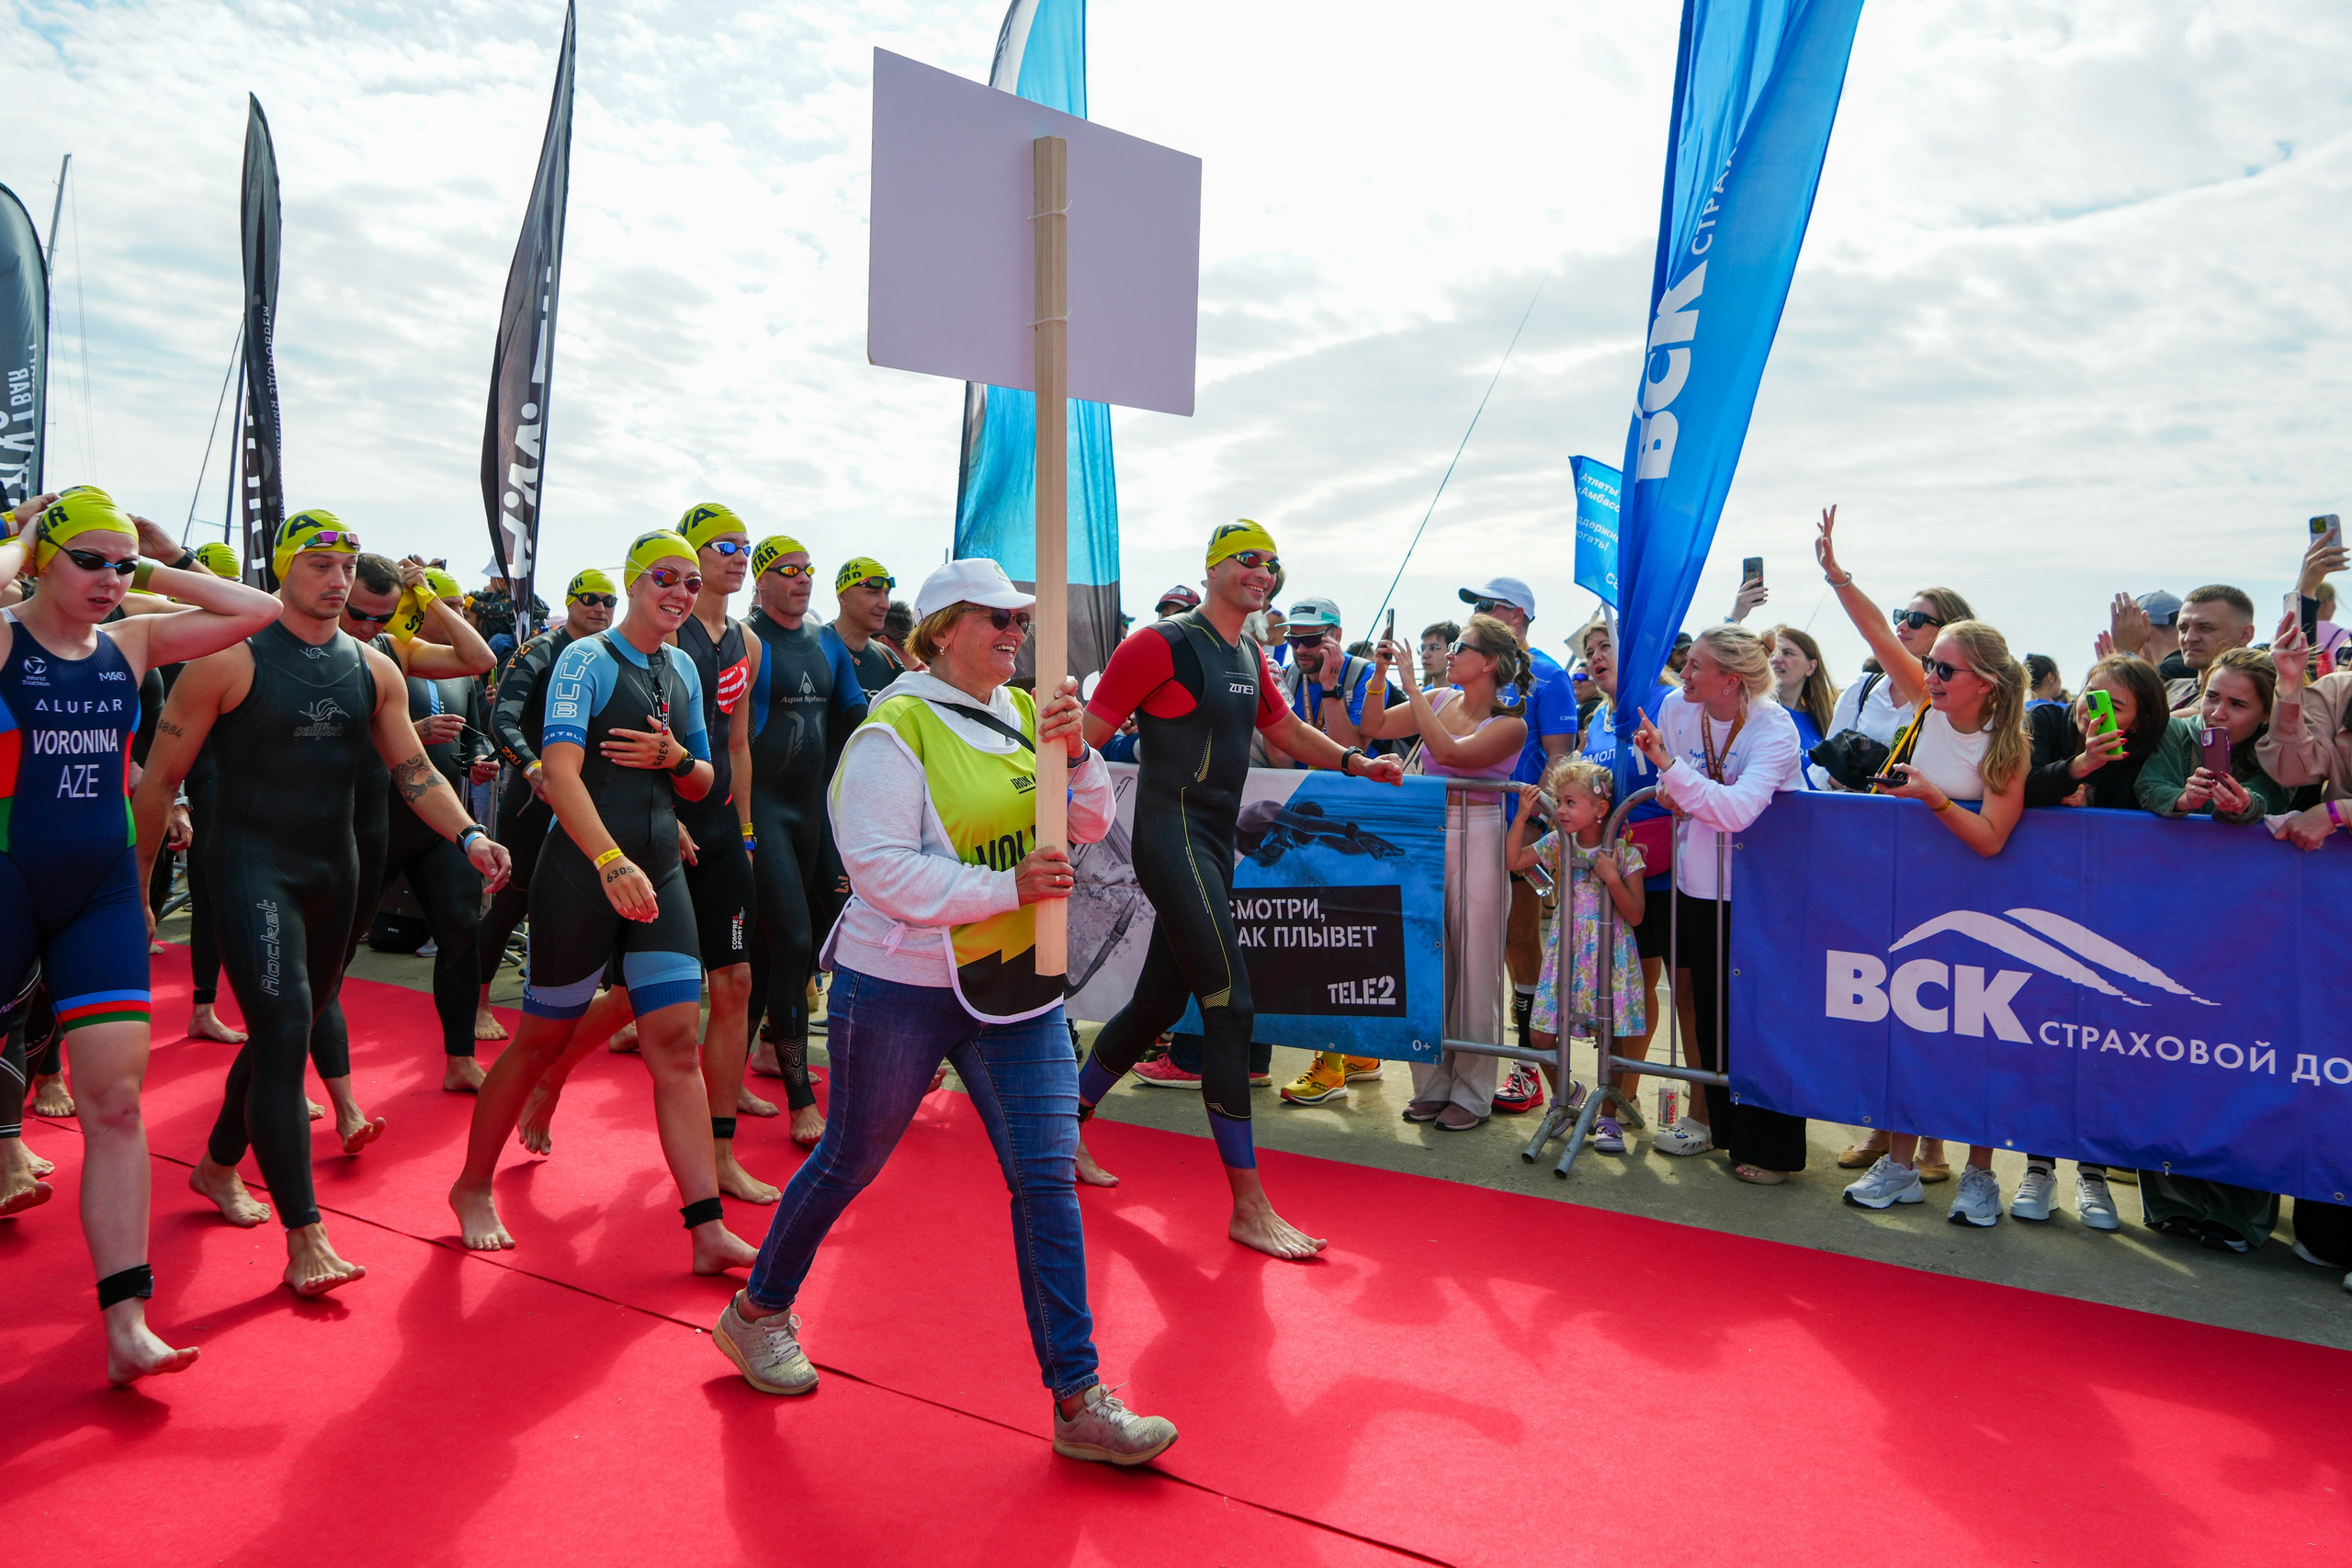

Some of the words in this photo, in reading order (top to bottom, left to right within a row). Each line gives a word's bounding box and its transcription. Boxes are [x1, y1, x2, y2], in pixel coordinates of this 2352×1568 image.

[1580, 472, 1619, 497] Атлеты
[22, 679, 51, 687] Triathlon
[552, 644, 598, 718] HUUB
[35, 698, 123, 714] ALUFAR
[780, 696, 803, 705] Aqua
[32, 728, 119, 755] VORONINA
[294, 722, 345, 741] sailfish
[56, 763, 99, 799] AZE
[1010, 775, 1033, 790] IRON
[606, 865, 636, 884] 6305
[256, 899, 280, 997] Rocket
[1273, 925, 1377, 948] ПЛЫВЕТ
[1327, 975, 1396, 1006] TELE2
[1825, 949, 2034, 1044] ВСК
[1411, 1039, 1431, 1052] 0+
[2039, 1021, 2277, 1075] СТРАХОВОЙ
